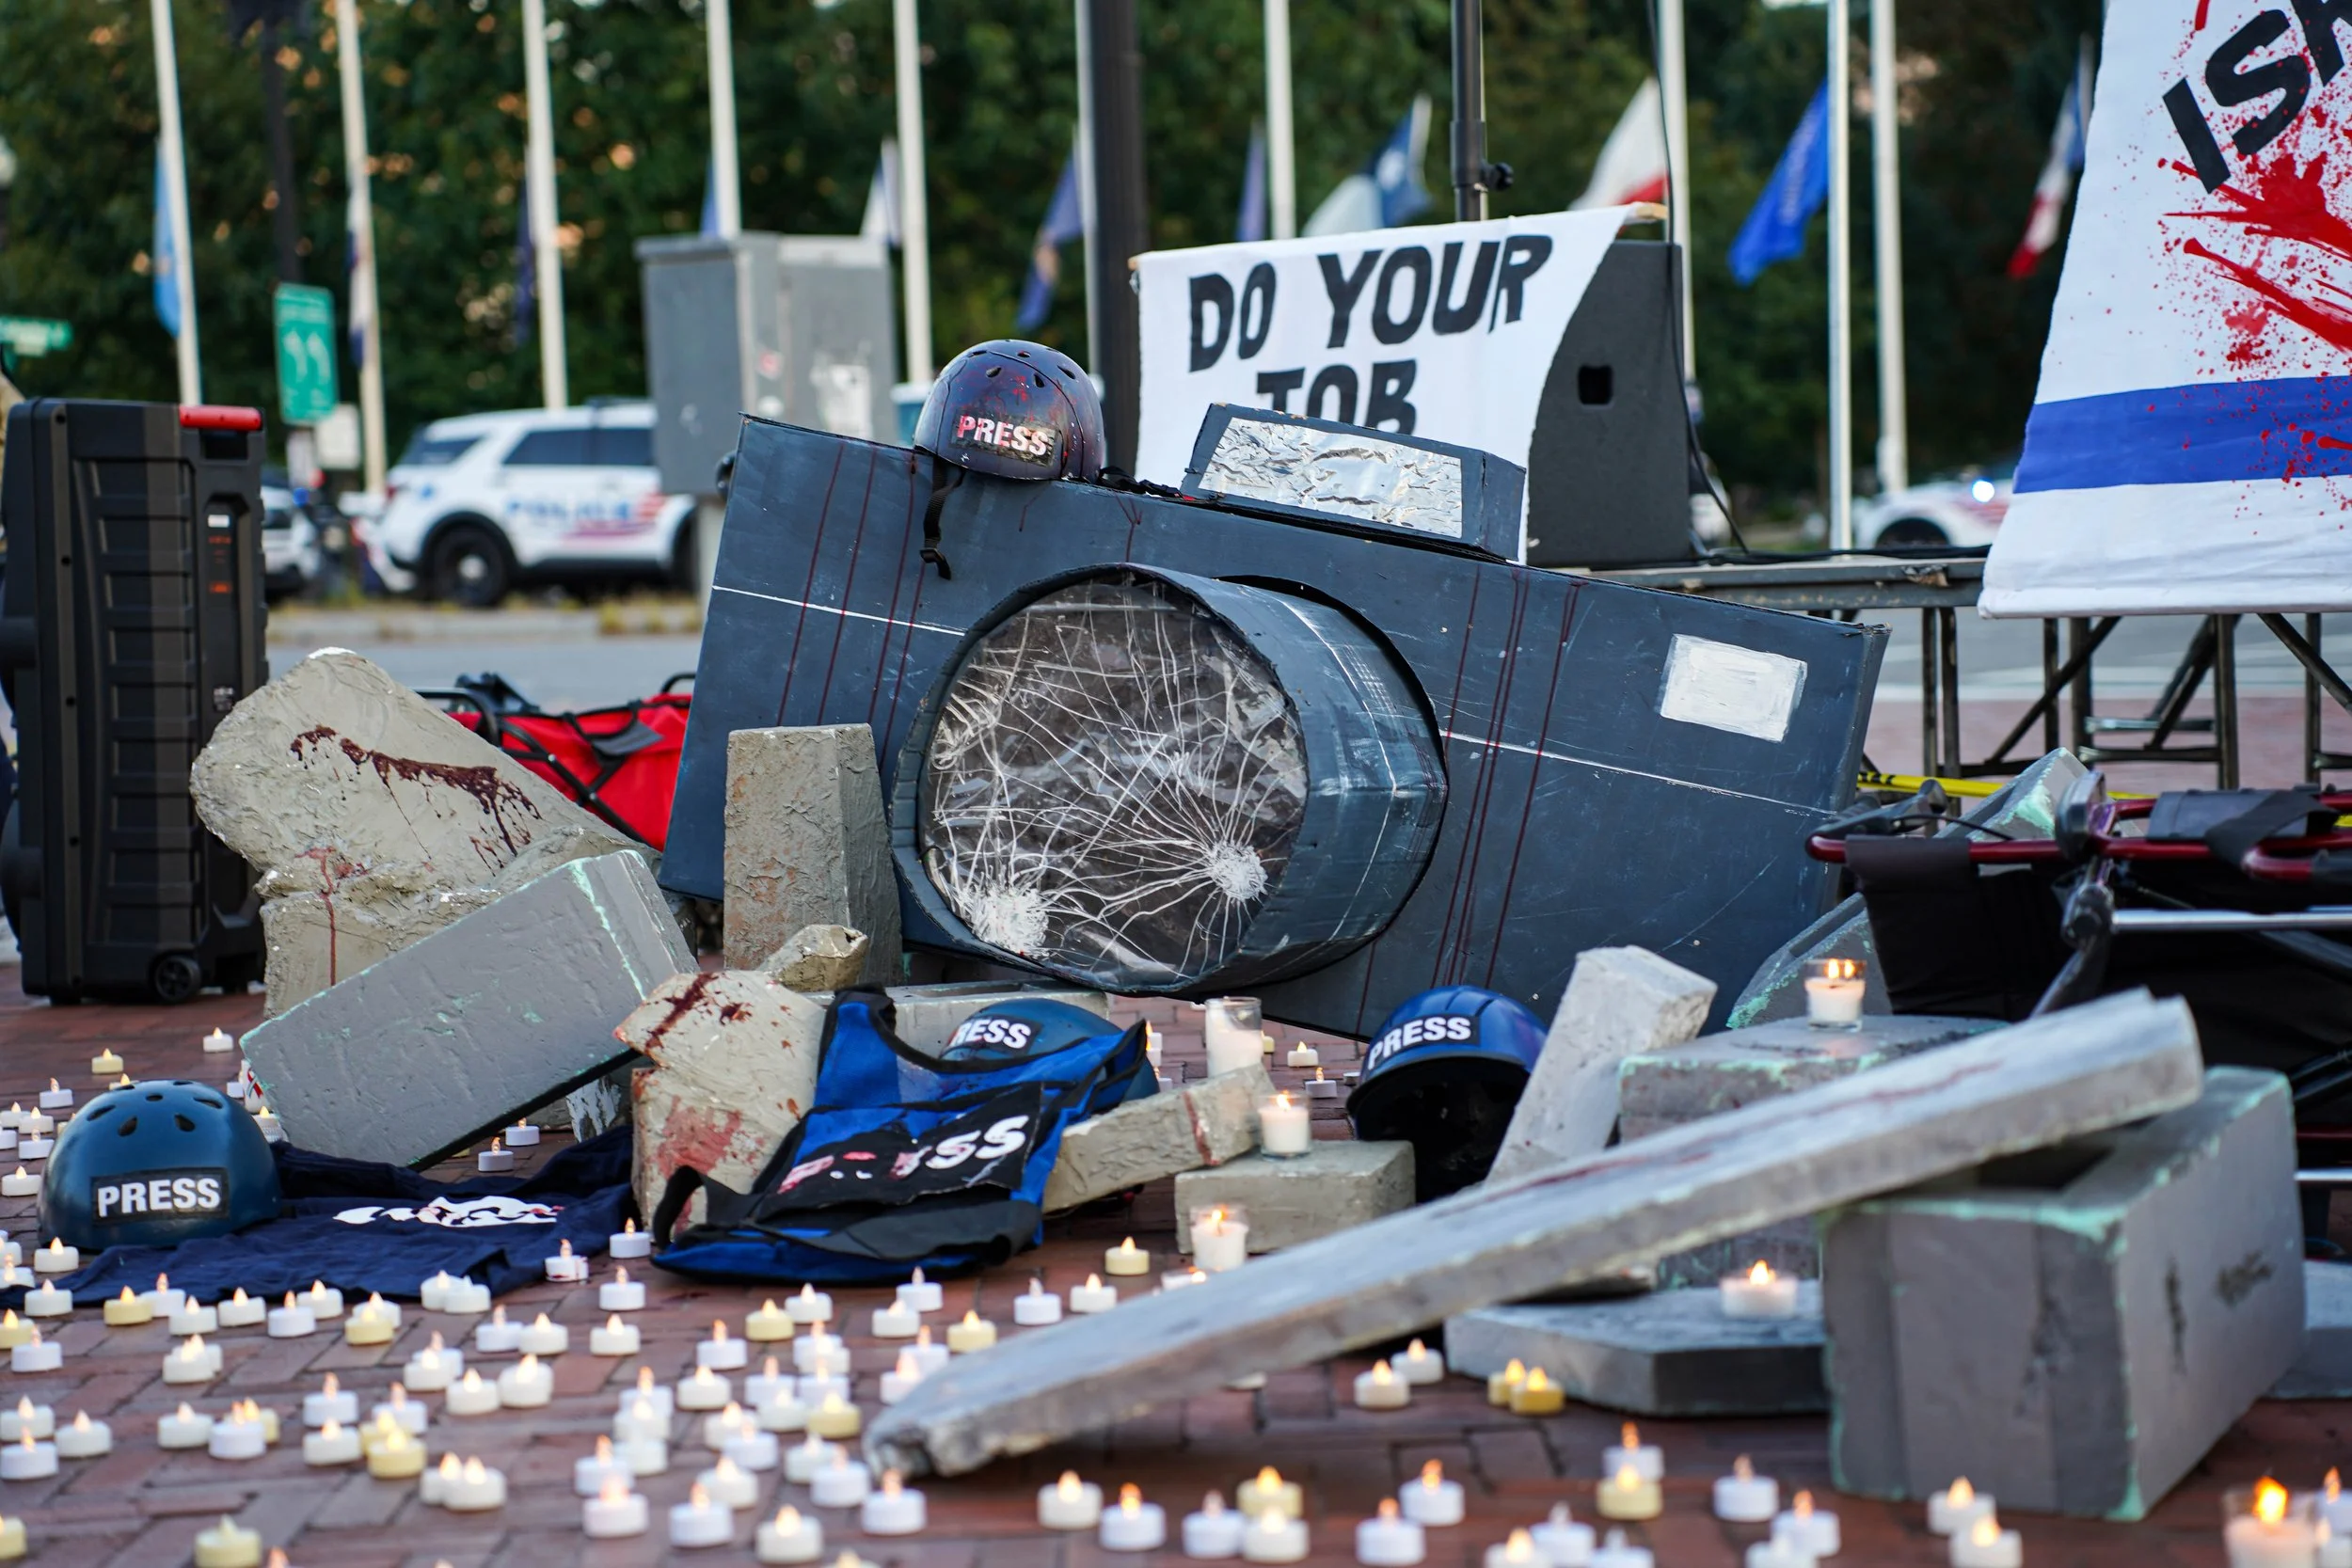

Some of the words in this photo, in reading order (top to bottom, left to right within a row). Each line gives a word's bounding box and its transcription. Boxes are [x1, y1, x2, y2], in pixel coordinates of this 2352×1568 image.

[1189, 261, 1277, 372] DO
[1317, 235, 1553, 349] YOUR
[957, 414, 1049, 456] PRESS
[946, 1018, 1032, 1050] RESS
[1367, 1016, 1471, 1070] PRESS
[98, 1178, 221, 1218] PRESS
